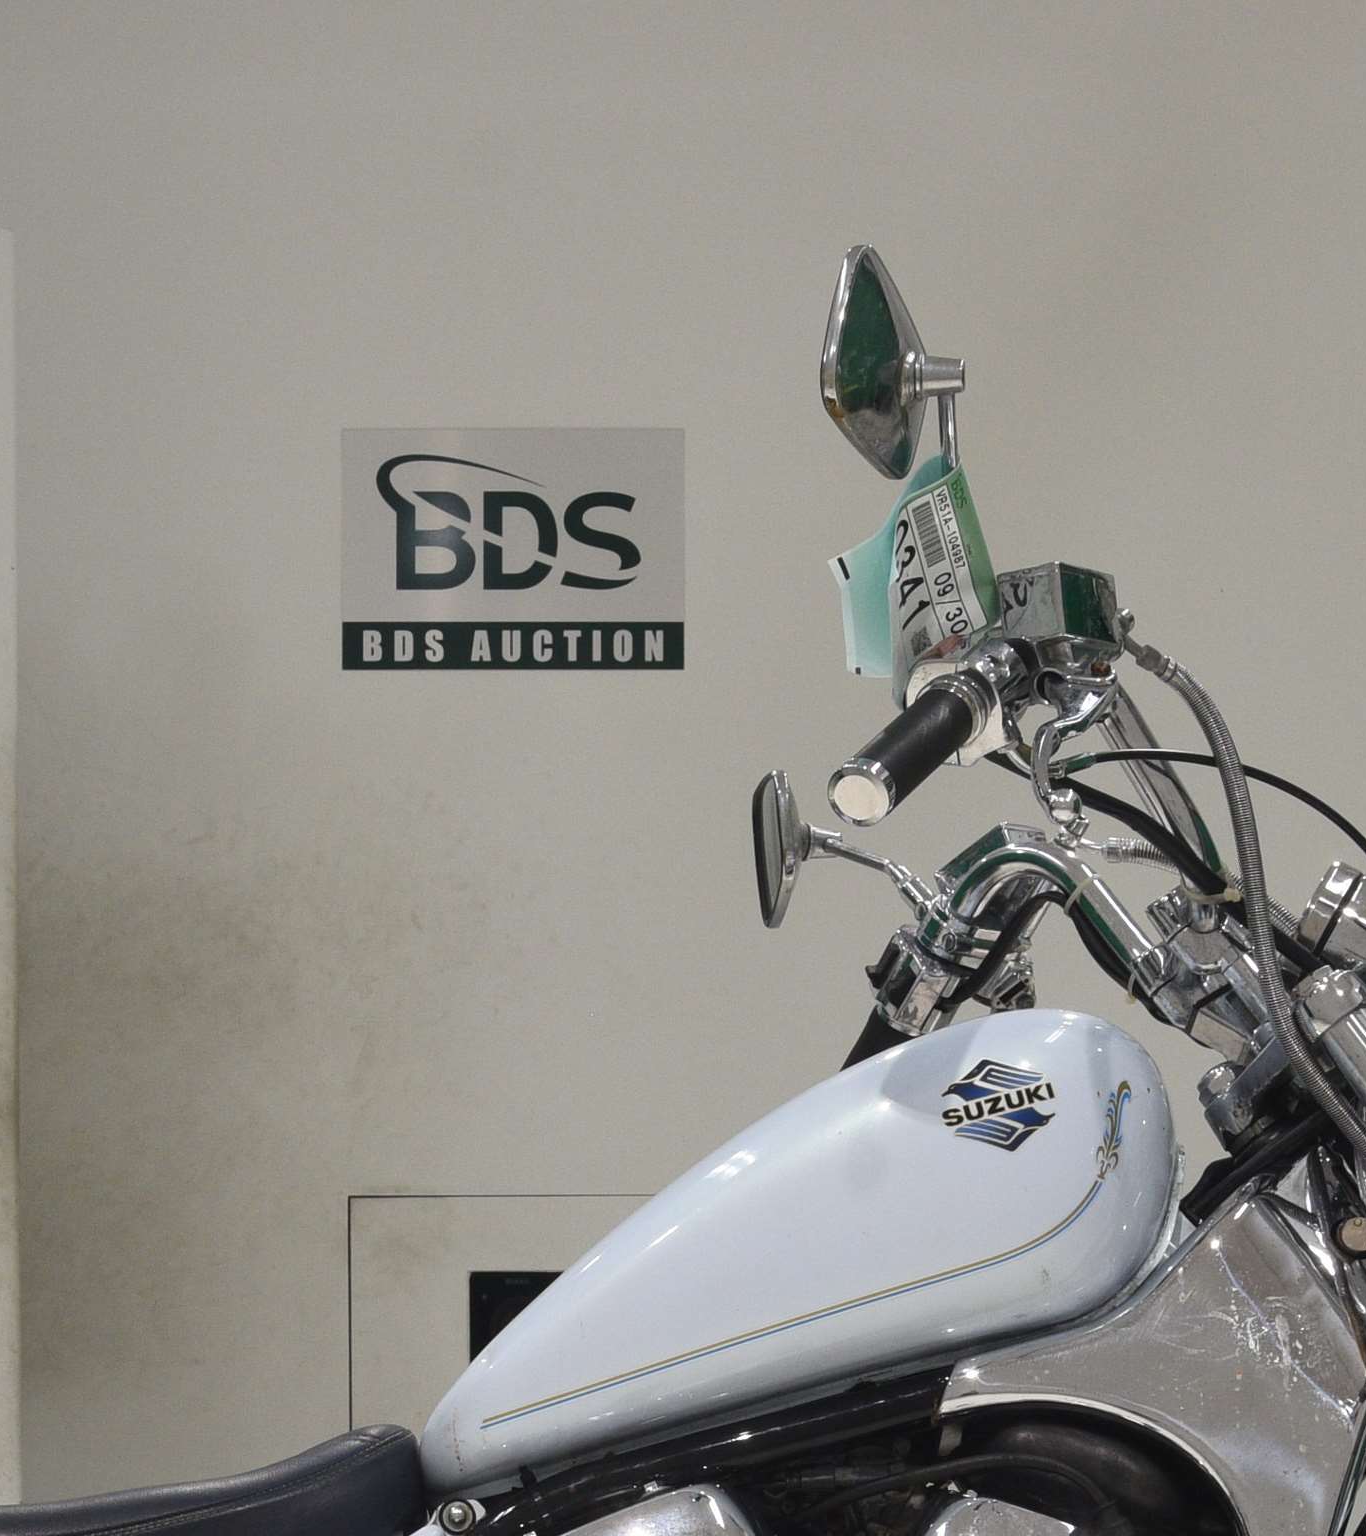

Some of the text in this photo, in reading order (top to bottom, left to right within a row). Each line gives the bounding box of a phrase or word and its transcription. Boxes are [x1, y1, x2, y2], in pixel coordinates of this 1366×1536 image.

[376, 454, 641, 590] BDS
[362, 630, 665, 662] BDS AUCTION
[941, 1082, 1056, 1127] SUZUKI
